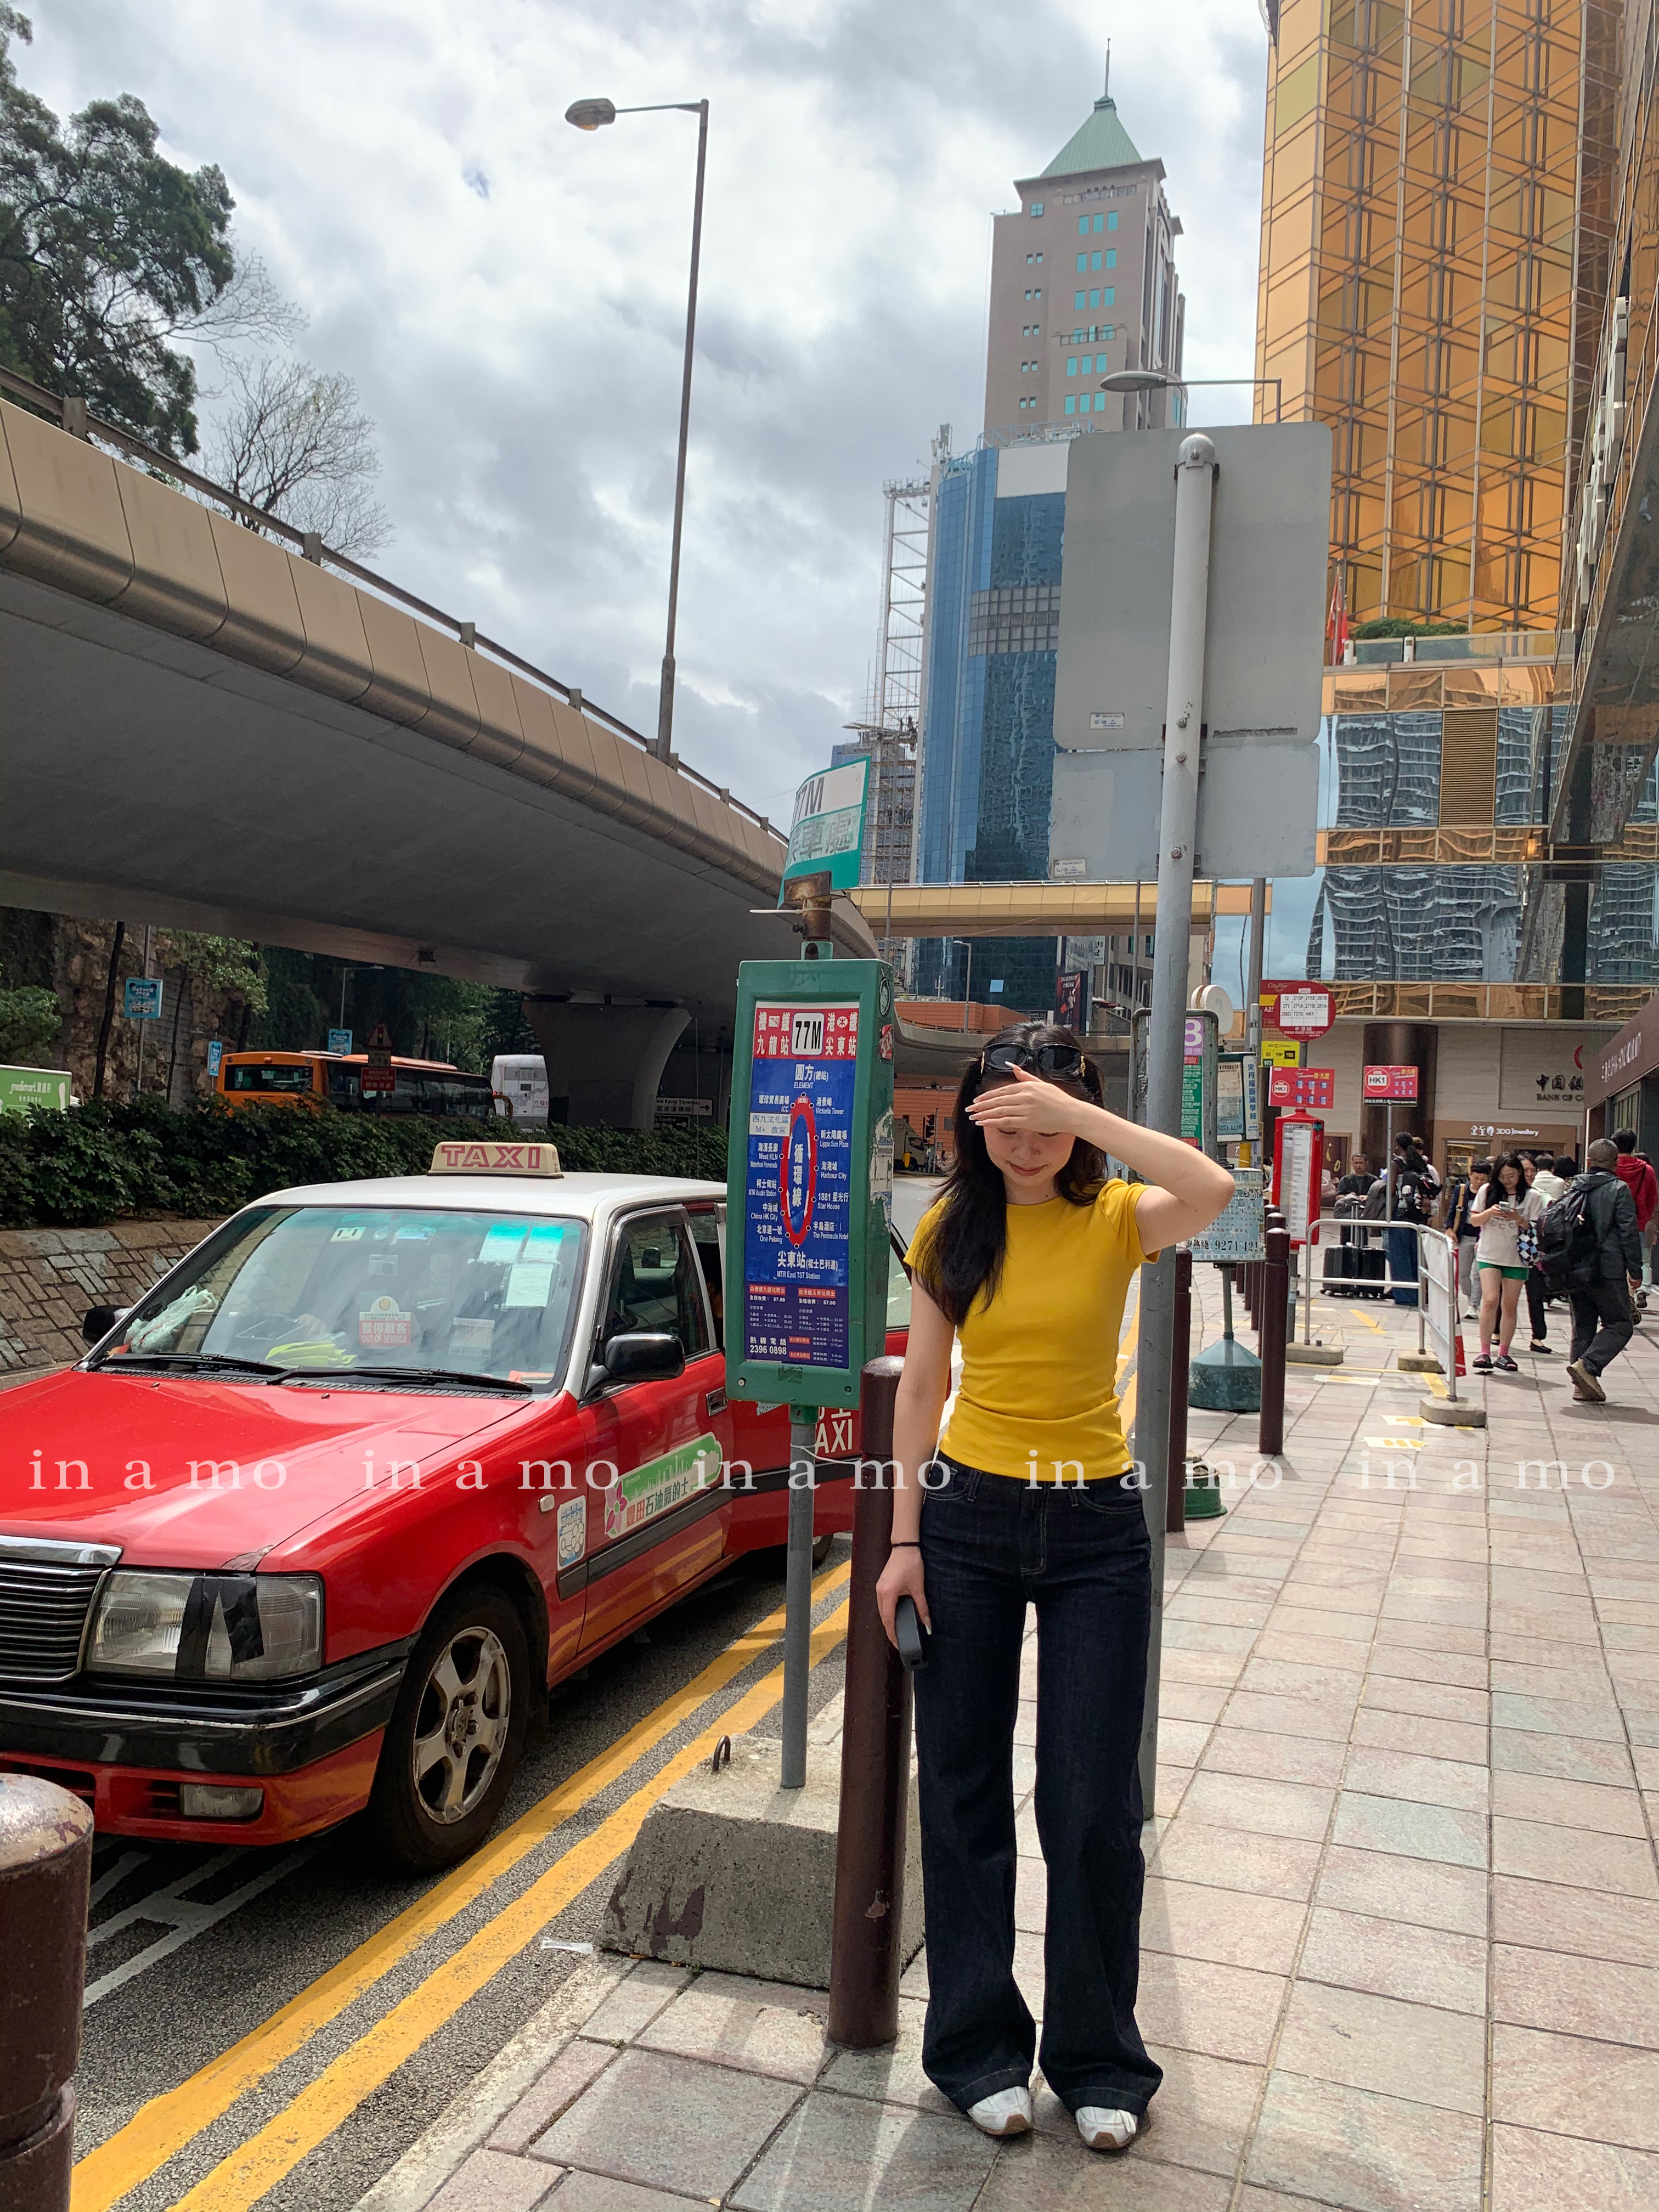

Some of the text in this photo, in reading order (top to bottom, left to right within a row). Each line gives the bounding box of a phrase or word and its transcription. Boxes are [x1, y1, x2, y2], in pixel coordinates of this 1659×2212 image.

[795, 1021, 821, 1049] 77M
[825, 1036, 857, 1056] 尖東站
[752, 1115, 789, 1124] 西九文化區
[1470, 1125, 1494, 1137] 金至尊
[1511, 1128, 1539, 1137] Jewellery
[442, 1146, 540, 1169] TAXI
[821, 1161, 837, 1171] 海港城
[838, 1172, 847, 1181] City
[818, 1192, 849, 1202] 1881 星光行
[763, 1203, 778, 1212] 中港城
[770, 1213, 778, 1222] City
[769, 1235, 782, 1244] Peking
[1215, 1240, 1238, 1251] 9271
[362, 1322, 407, 1334] 暫停載客
[383, 1335, 407, 1343] SERVICE
[750, 1345, 787, 1355] 2396 0898
[815, 1419, 853, 1455] AXI
[626, 1476, 689, 1528] 豐田石油氣的士
